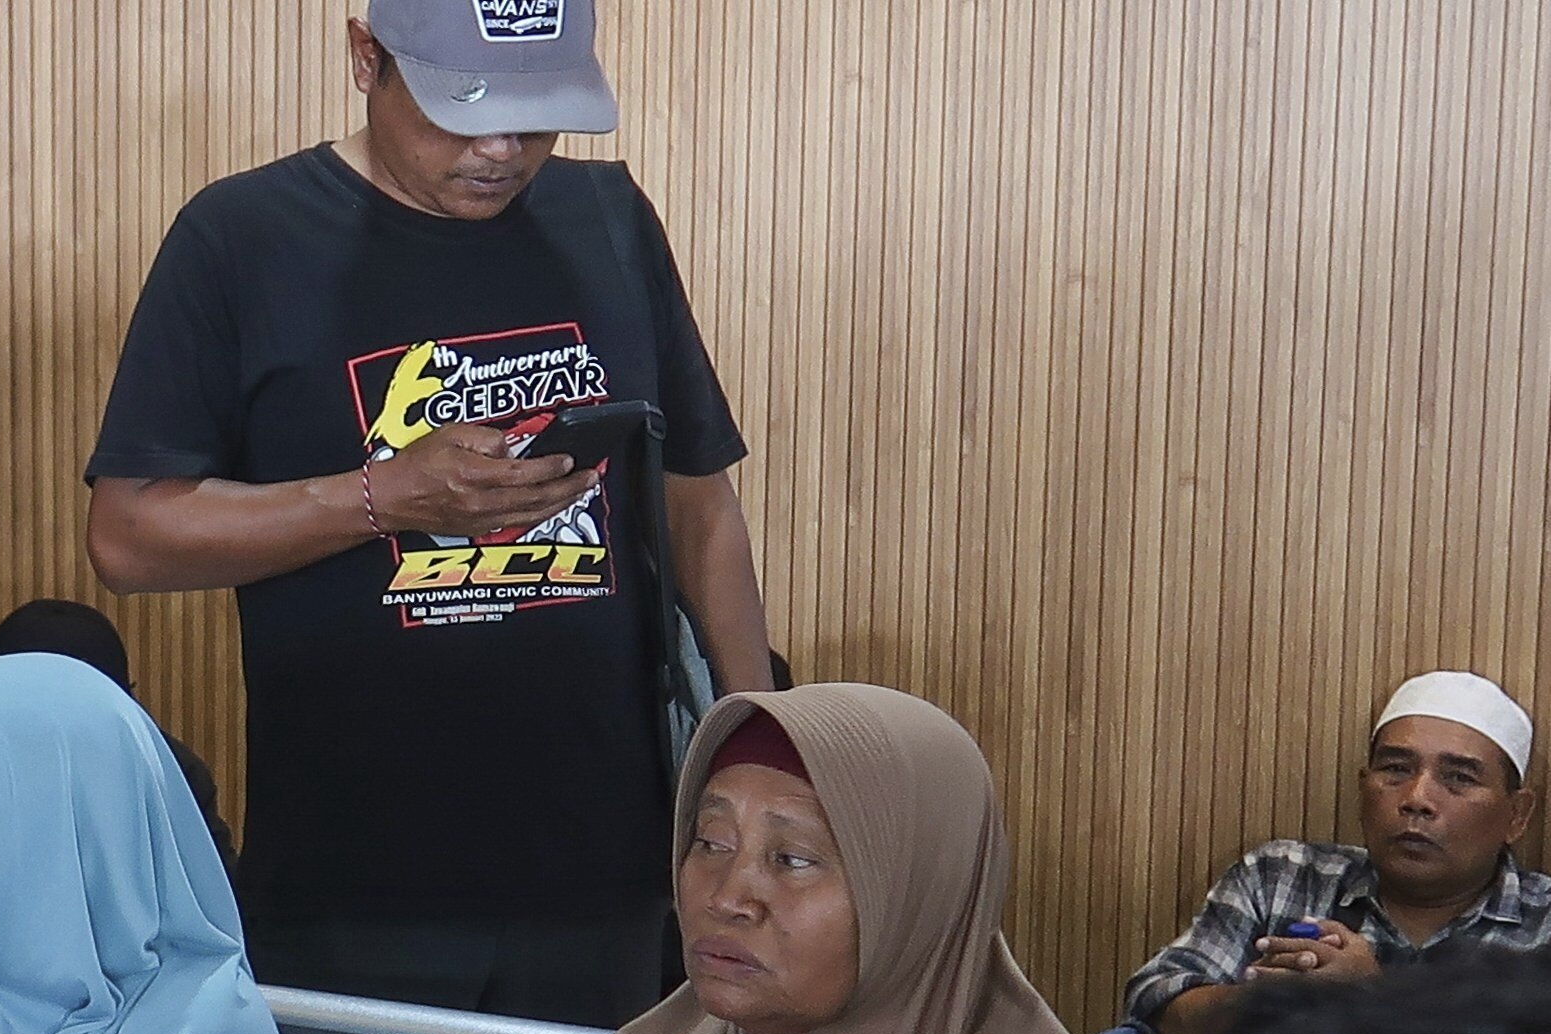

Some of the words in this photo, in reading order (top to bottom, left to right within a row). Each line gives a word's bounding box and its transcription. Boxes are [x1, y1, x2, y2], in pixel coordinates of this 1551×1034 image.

[494, 0, 547, 16] VANS
[444, 344, 591, 387] Anniversary
[425, 362, 607, 427] GEBYAR
[388, 545, 606, 590] BCC
[382, 589, 491, 605] BANYUWANGI
[495, 587, 537, 598] CIVIC
[541, 586, 609, 597] COMMUNITY
